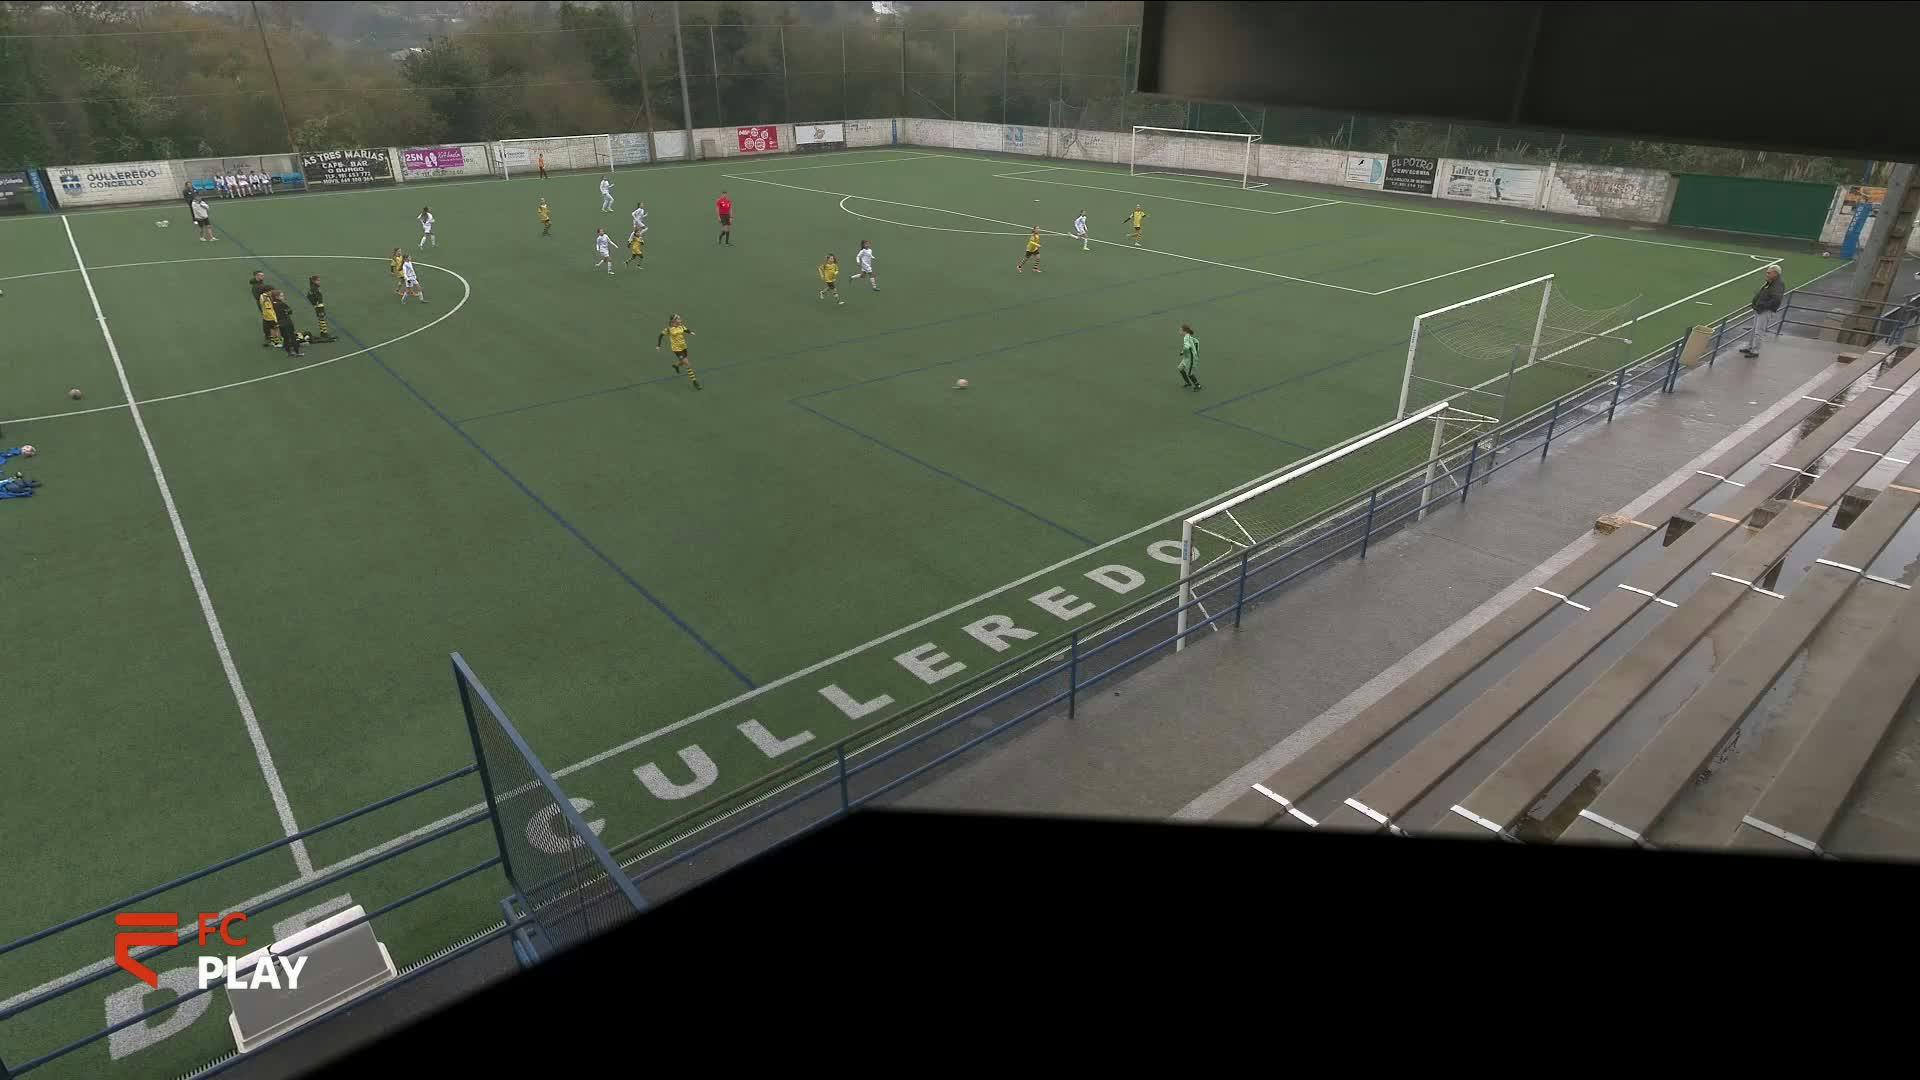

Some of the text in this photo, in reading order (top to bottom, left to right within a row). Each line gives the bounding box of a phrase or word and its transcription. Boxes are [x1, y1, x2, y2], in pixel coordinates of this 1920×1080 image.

[304, 149, 384, 167] AS TRES MARIAS
[405, 153, 423, 162] 25N
[350, 160, 369, 168] BAR
[1391, 158, 1434, 171] EL POTRO
[1452, 165, 1489, 177] Talleres
[89, 180, 144, 189] CONCELLO
